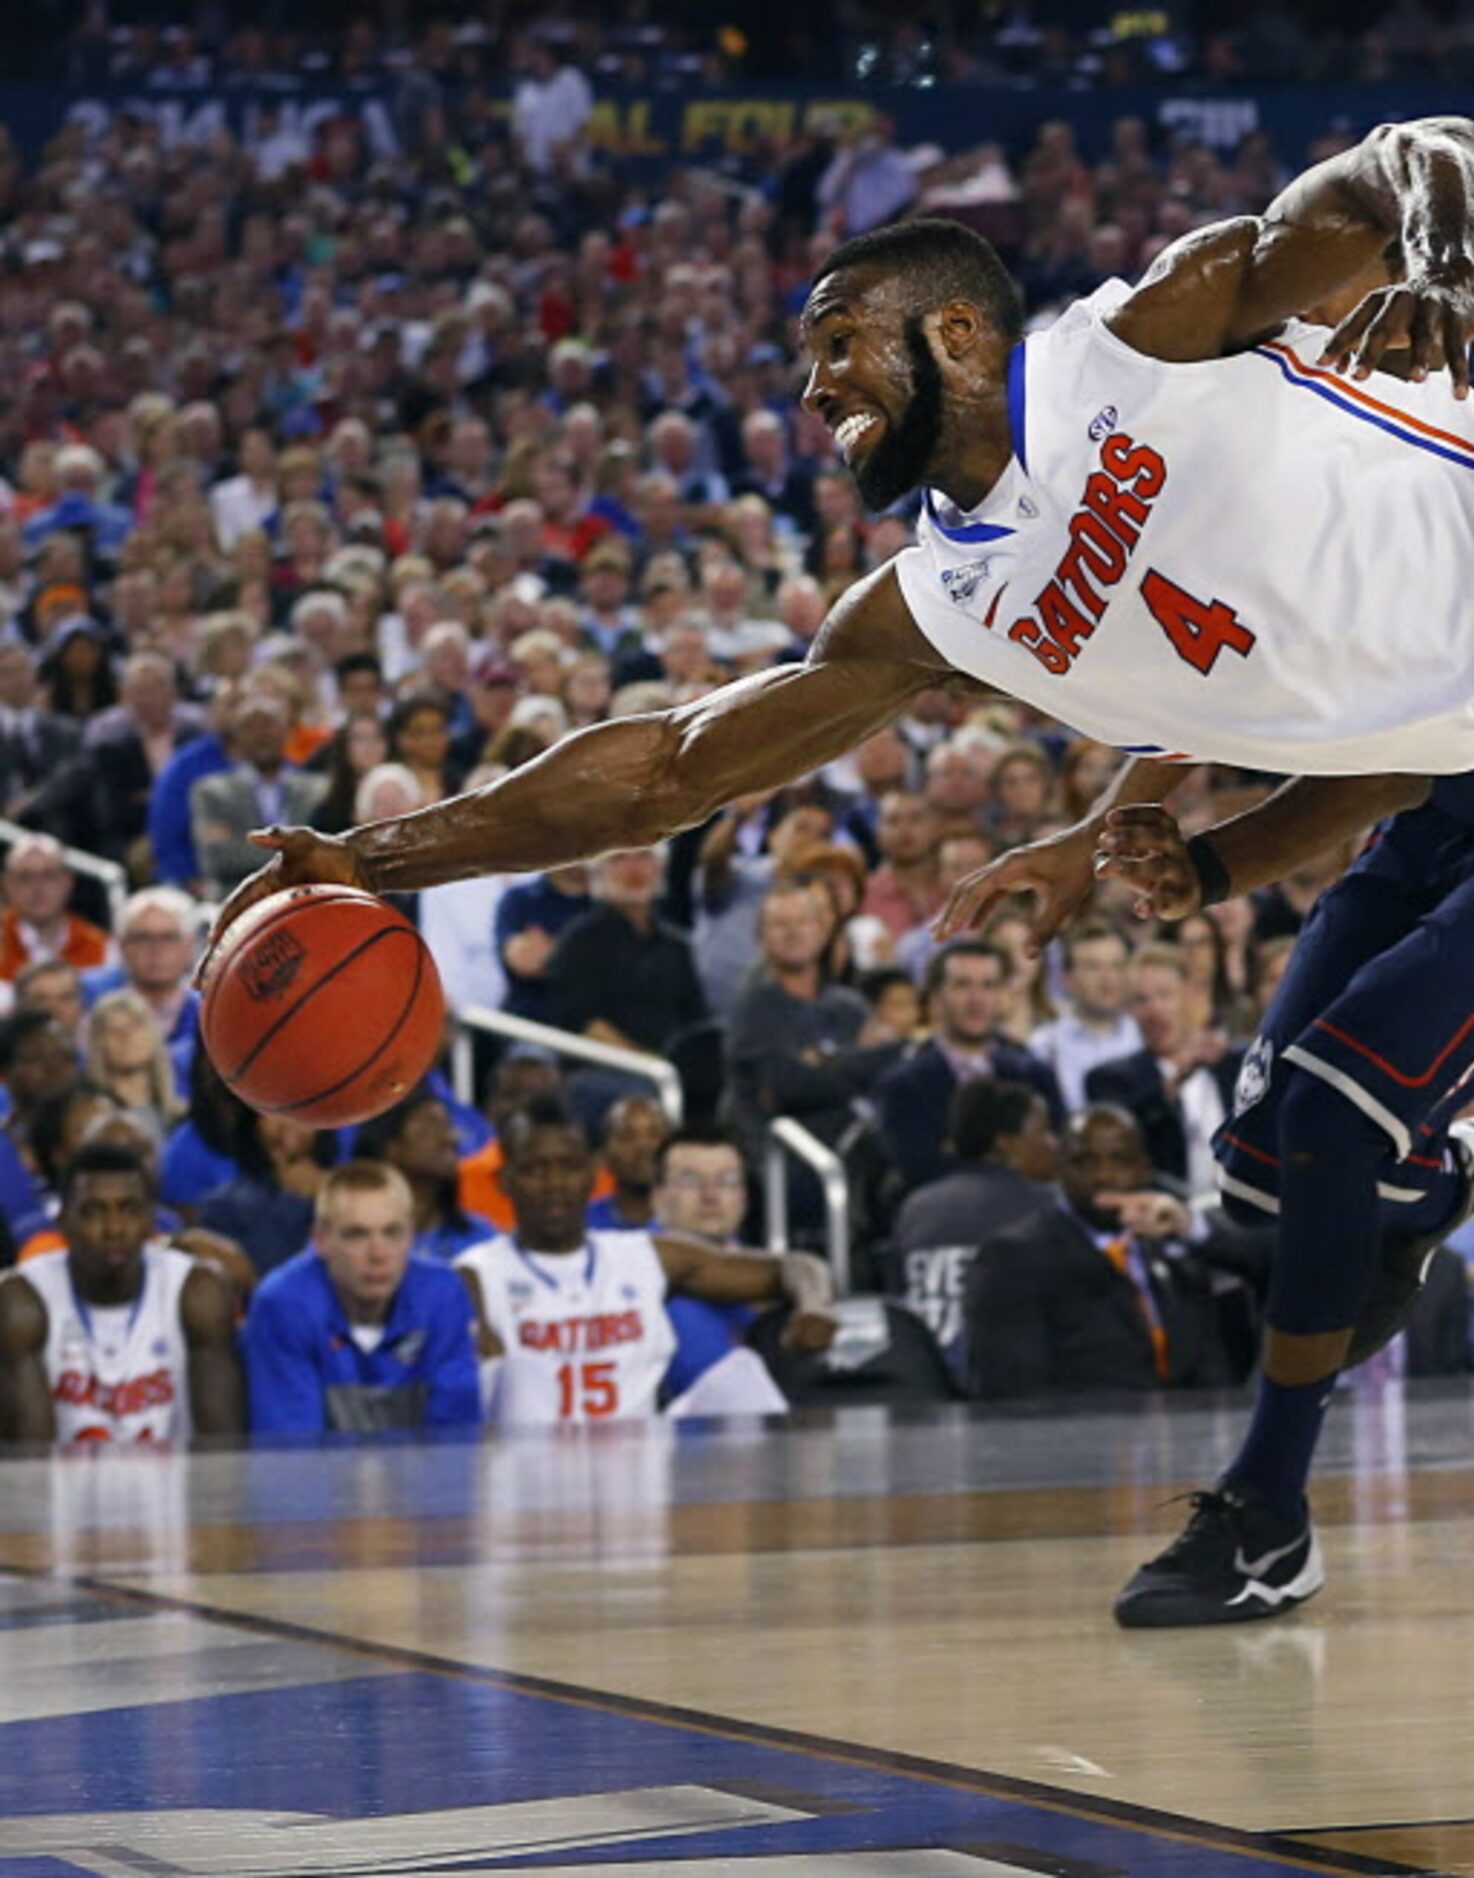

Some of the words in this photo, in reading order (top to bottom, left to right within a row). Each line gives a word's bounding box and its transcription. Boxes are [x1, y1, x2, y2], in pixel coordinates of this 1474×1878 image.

[1007, 433, 1168, 676] GATORS
[1140, 567, 1257, 677] 4
[519, 1309, 643, 1353] GATORS
[557, 1361, 619, 1419] 15
